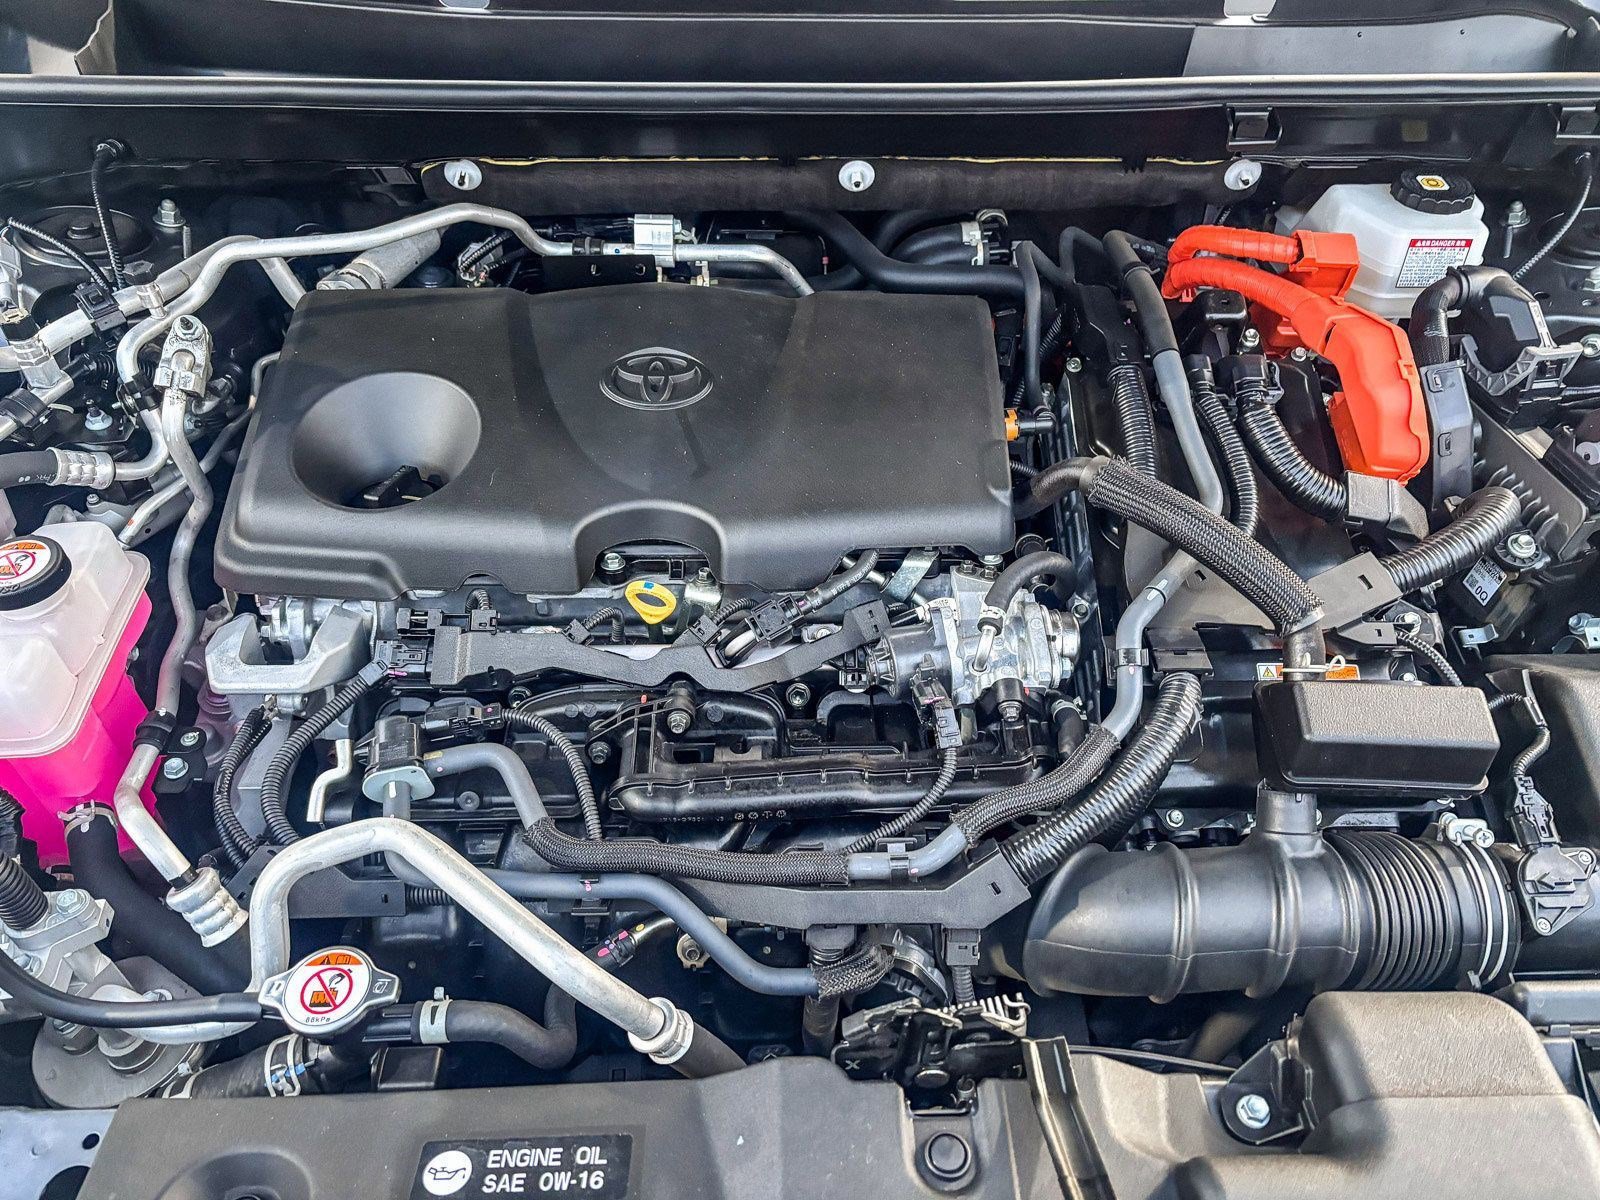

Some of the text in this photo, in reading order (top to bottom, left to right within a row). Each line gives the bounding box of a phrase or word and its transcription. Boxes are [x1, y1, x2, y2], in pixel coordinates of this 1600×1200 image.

[487, 1146, 608, 1168] ENGINE OIL
[482, 1173, 526, 1193] SAE
